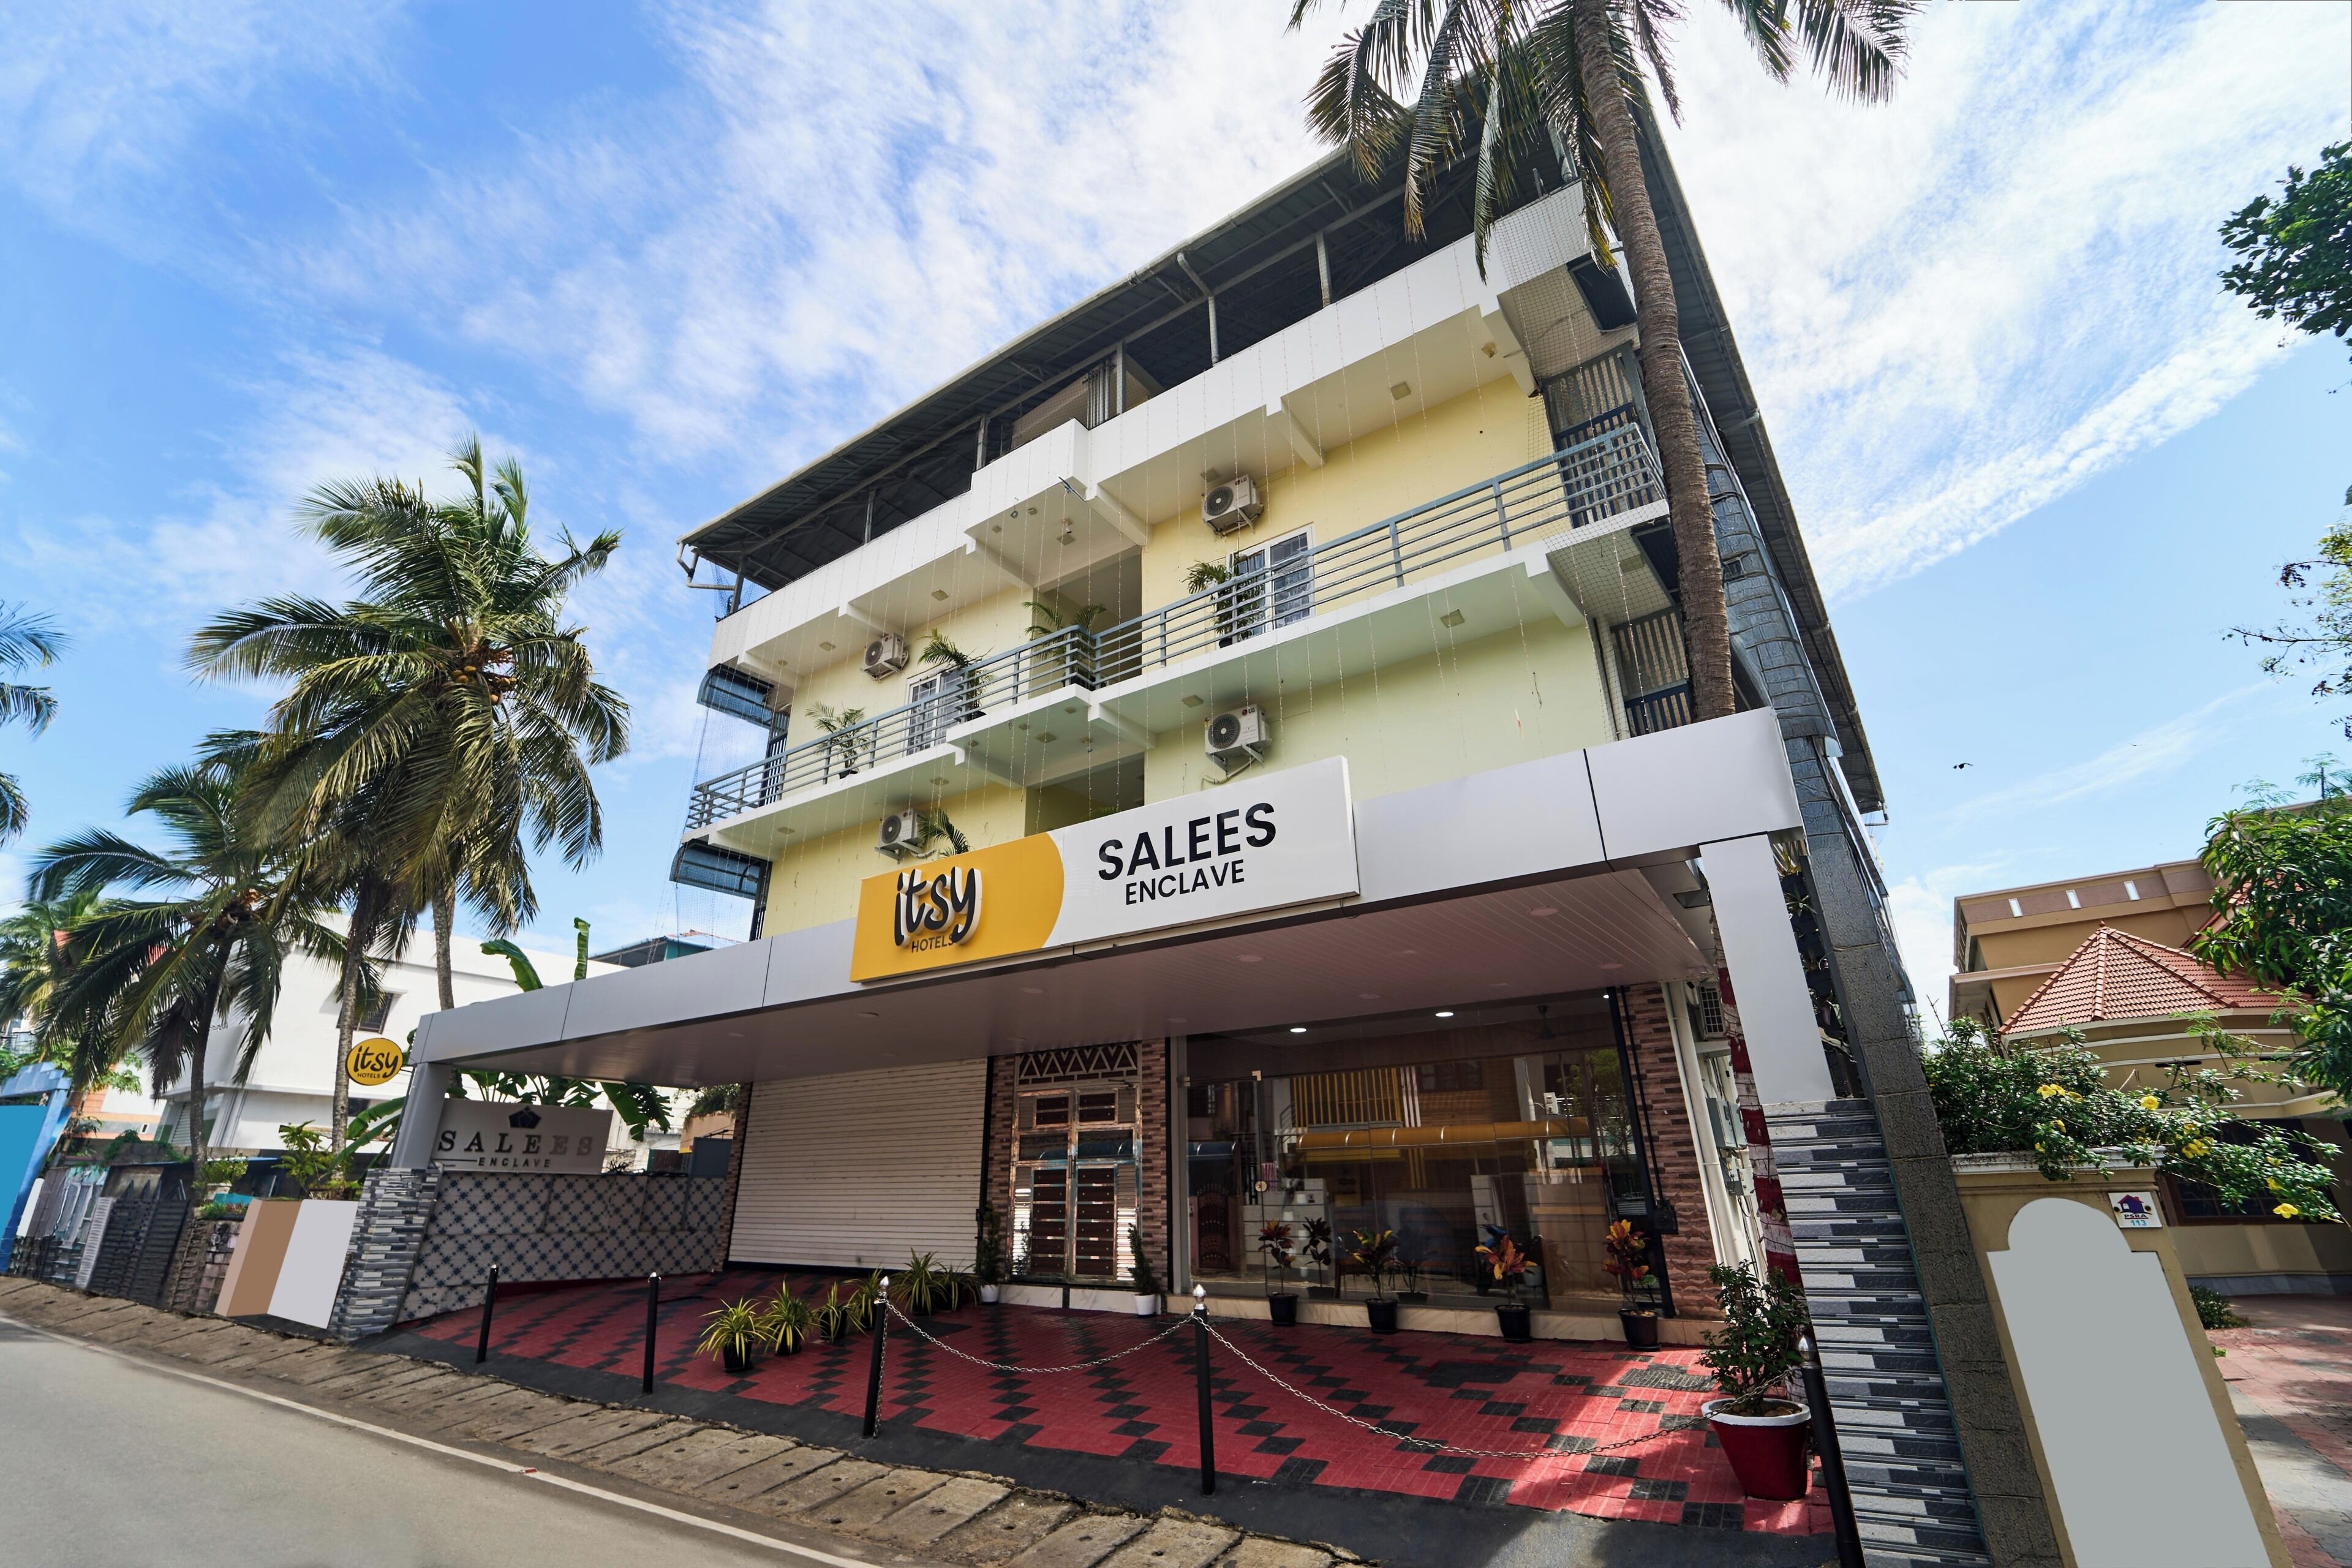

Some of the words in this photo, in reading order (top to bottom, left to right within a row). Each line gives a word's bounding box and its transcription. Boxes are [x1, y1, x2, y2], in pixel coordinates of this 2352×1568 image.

[1099, 802, 1276, 880] SALEES
[1126, 859, 1245, 905] ENCLAVE
[895, 866, 981, 947] itsy
[911, 935, 954, 952] HOTELS
[354, 1046, 398, 1078] itsy
[438, 1130, 593, 1156] SALEES
[478, 1157, 550, 1168] ENCLAVE
